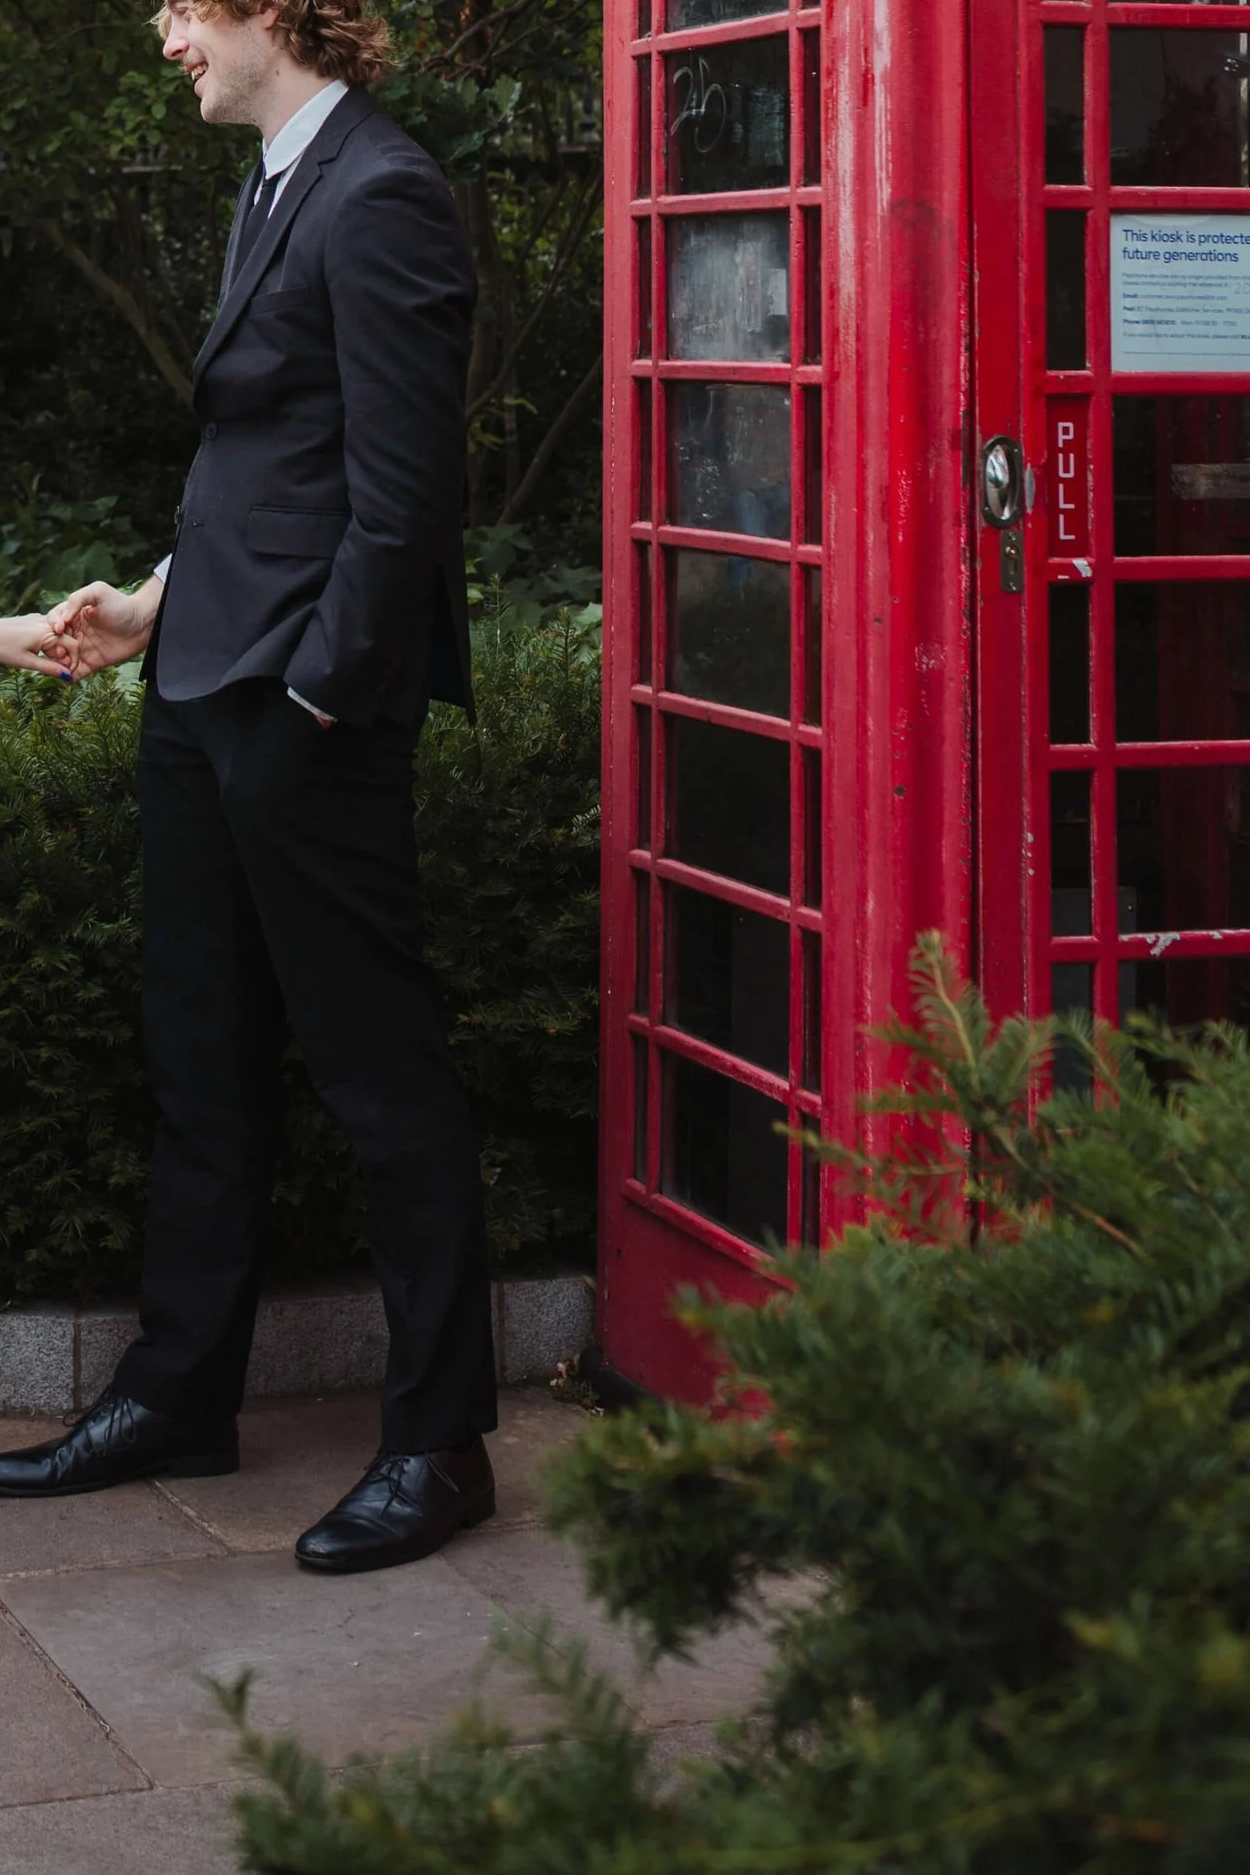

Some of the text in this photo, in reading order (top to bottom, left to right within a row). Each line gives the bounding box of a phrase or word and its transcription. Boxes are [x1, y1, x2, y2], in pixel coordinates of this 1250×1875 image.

[1122, 229, 1148, 242] This
[1150, 230, 1183, 243] kiosk
[1186, 231, 1196, 243] is
[1122, 247, 1239, 263] future generations
[1057, 422, 1075, 540] PULL
